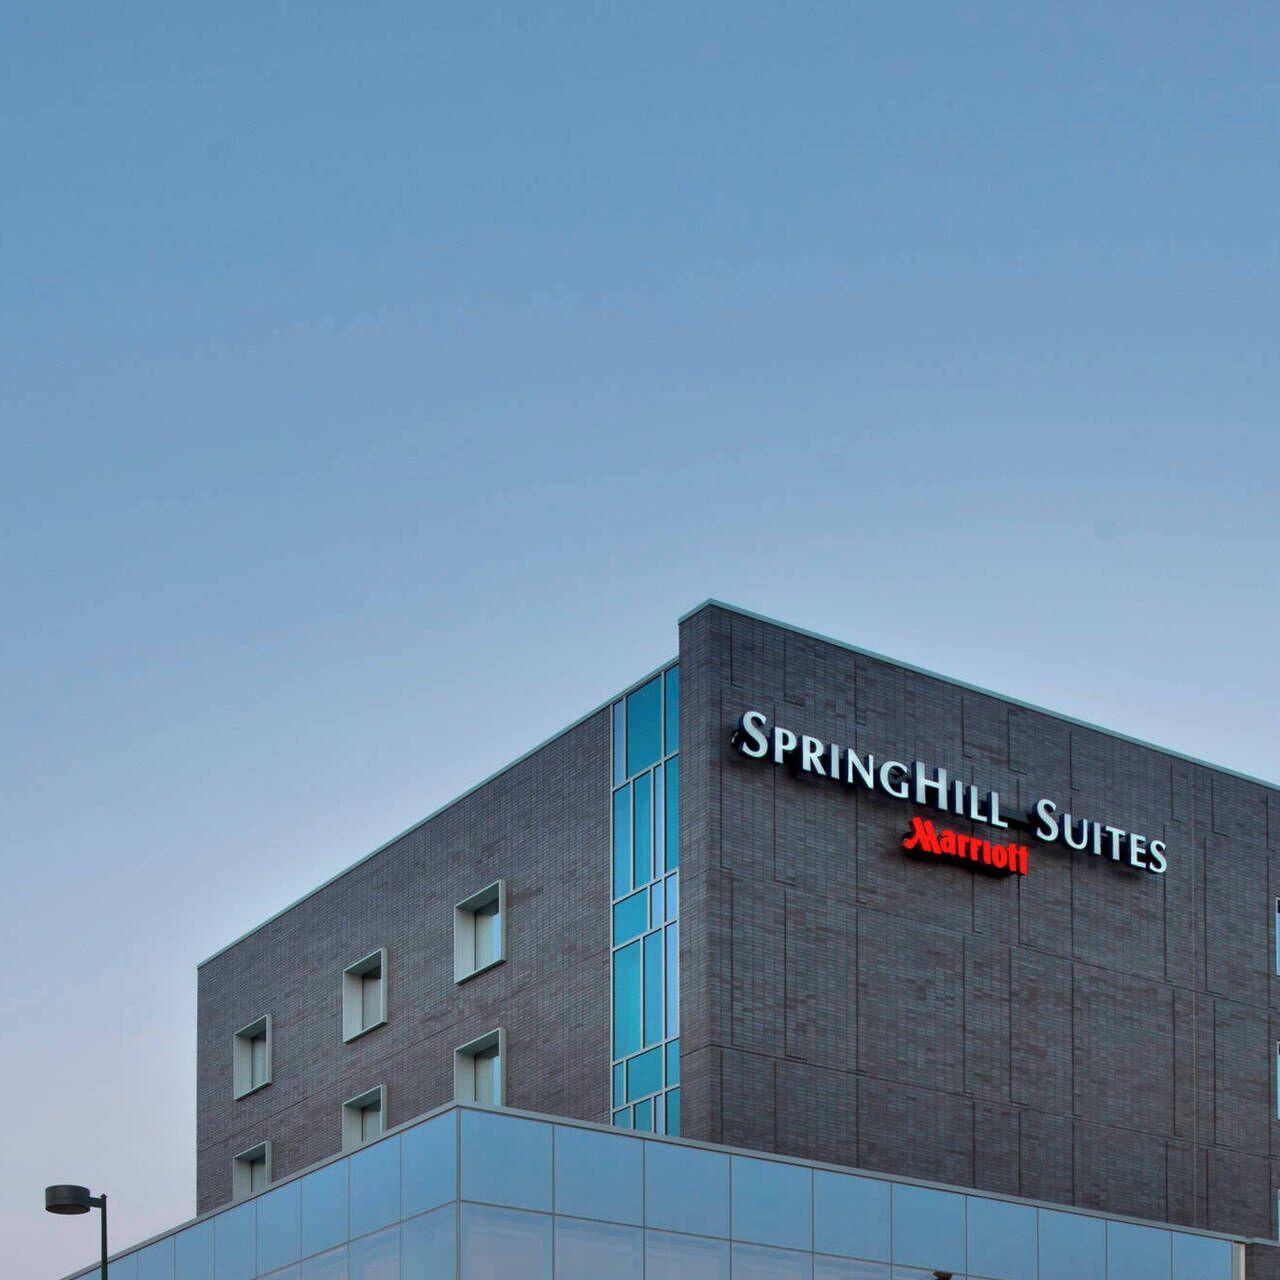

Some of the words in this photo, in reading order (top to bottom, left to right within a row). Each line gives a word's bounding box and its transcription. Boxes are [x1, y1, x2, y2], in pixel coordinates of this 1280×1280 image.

[739, 710, 1009, 829] SPRINGHILL
[1034, 798, 1168, 874] SUITES
[902, 816, 1029, 875] Marriott
